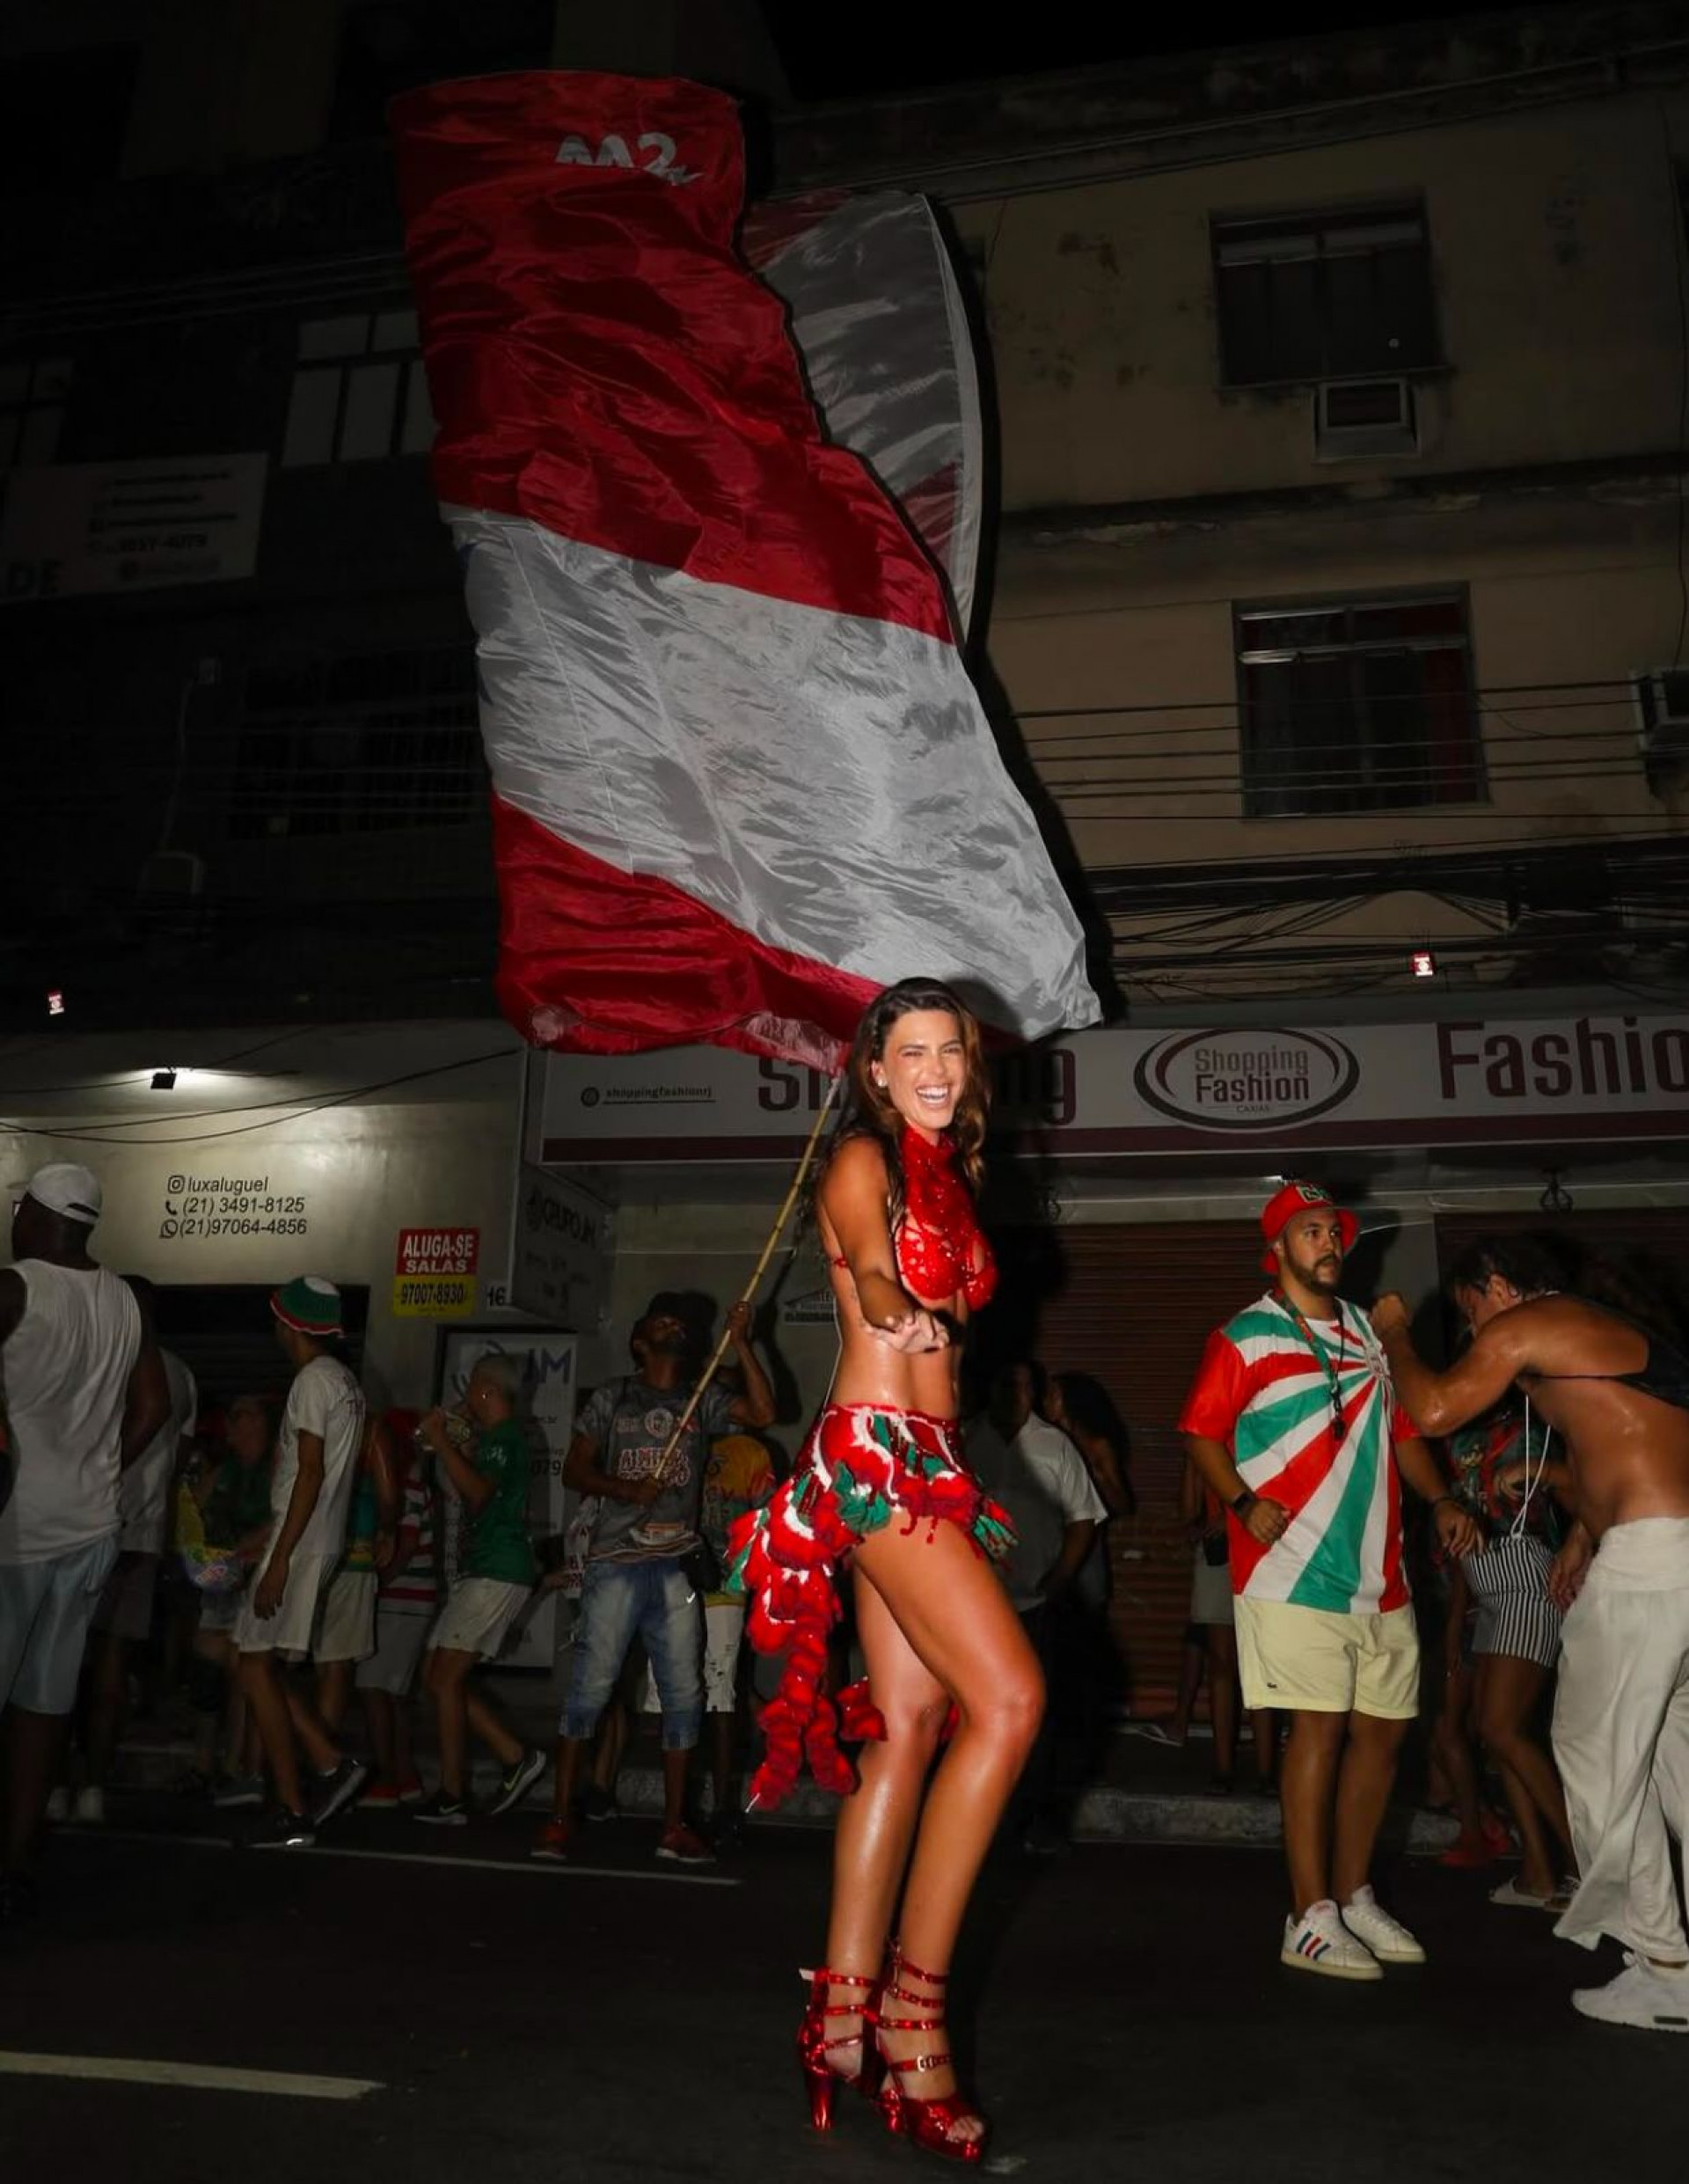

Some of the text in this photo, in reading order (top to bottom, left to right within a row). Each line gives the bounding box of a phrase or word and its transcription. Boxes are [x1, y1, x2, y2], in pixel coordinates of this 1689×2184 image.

[1195, 1045, 1309, 1076] Shopping
[1196, 1072, 1309, 1103] Fashion
[1236, 1103, 1270, 1114] CAXIAS
[188, 1176, 268, 1195] luxaluguel
[183, 1197, 305, 1217] (21) 3491-8125
[179, 1219, 307, 1237] (21)97064-4856
[402, 1234, 475, 1258] ALUGA-SE
[405, 1258, 468, 1274] SALAS
